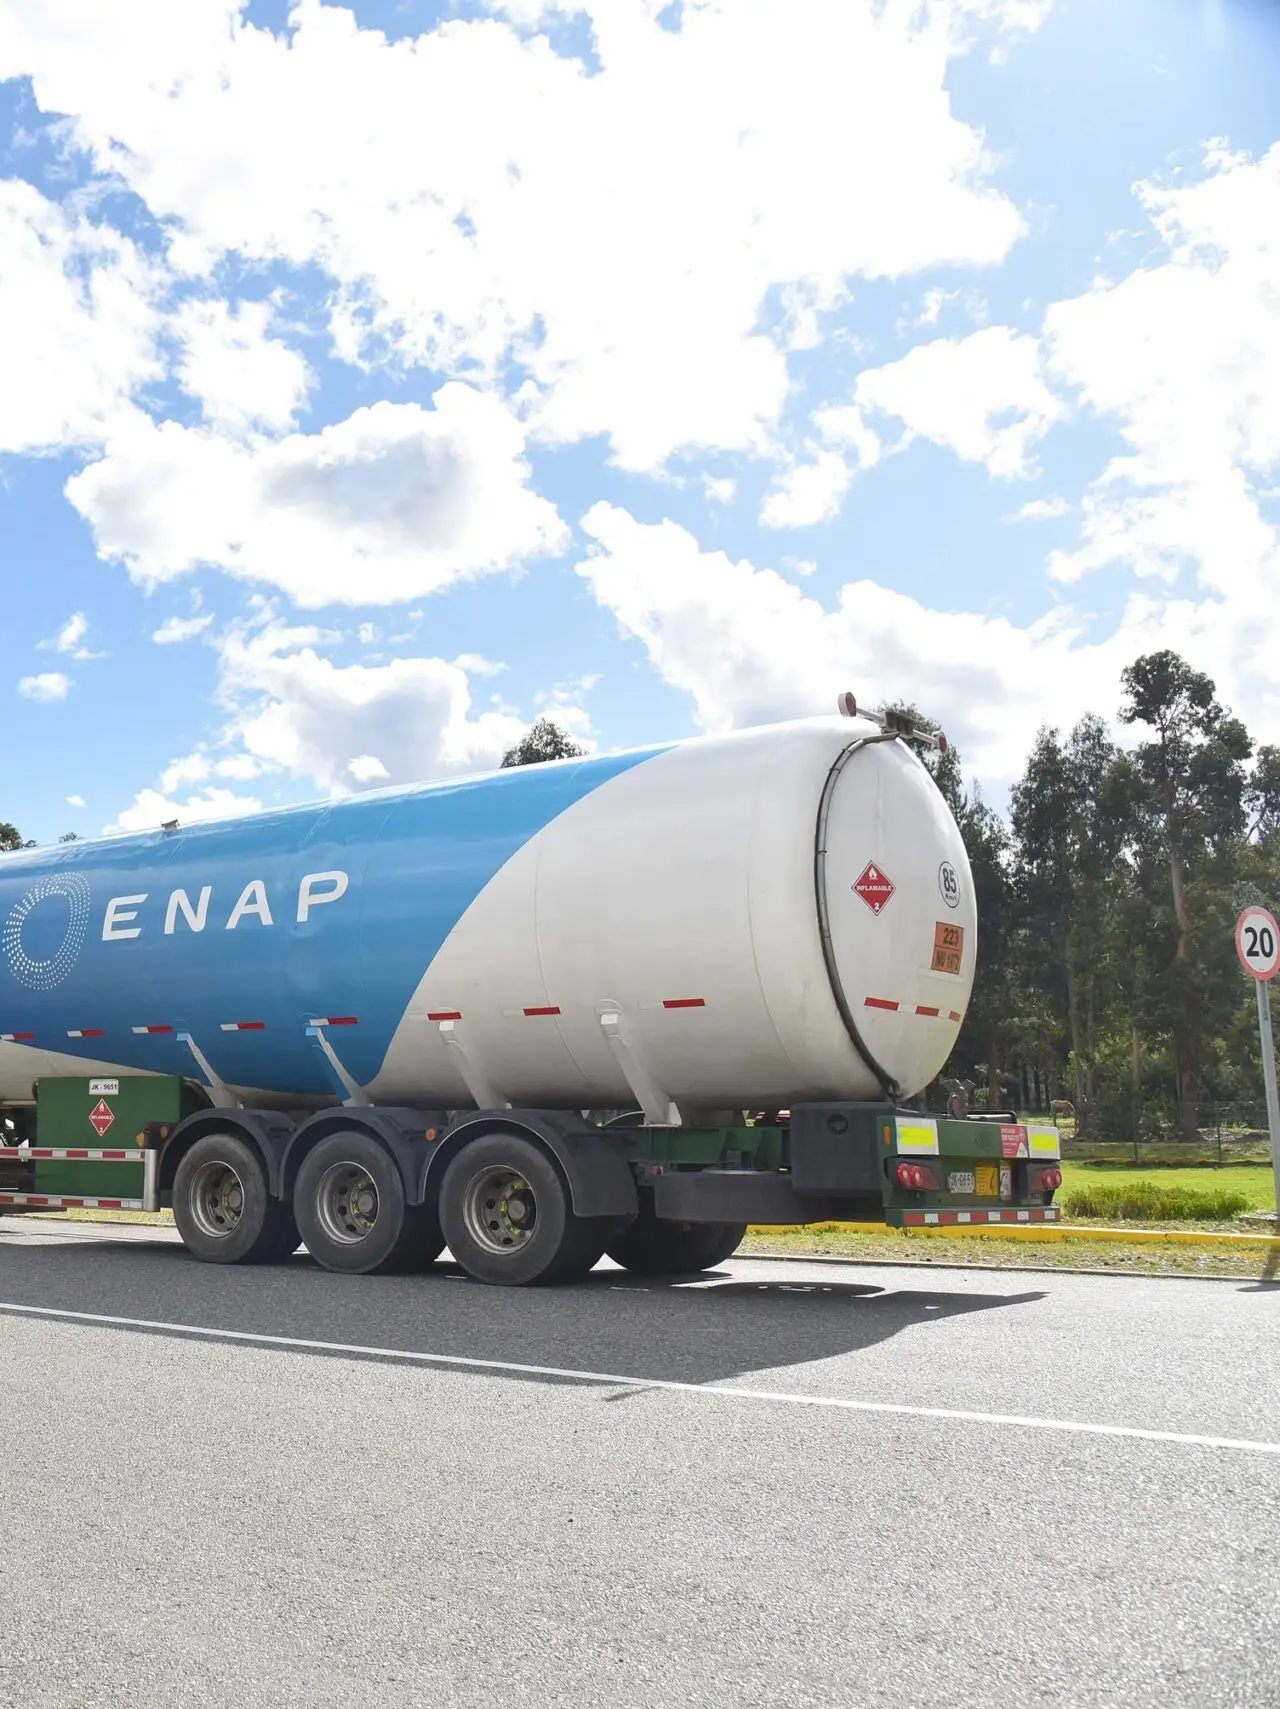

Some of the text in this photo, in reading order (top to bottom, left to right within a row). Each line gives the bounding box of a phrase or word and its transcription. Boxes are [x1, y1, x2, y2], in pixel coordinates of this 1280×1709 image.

[942, 868, 957, 893] 85
[101, 870, 349, 941] ENAP
[874, 902, 880, 910] 2
[943, 928, 959, 946] 223
[1244, 927, 1274, 958] 20
